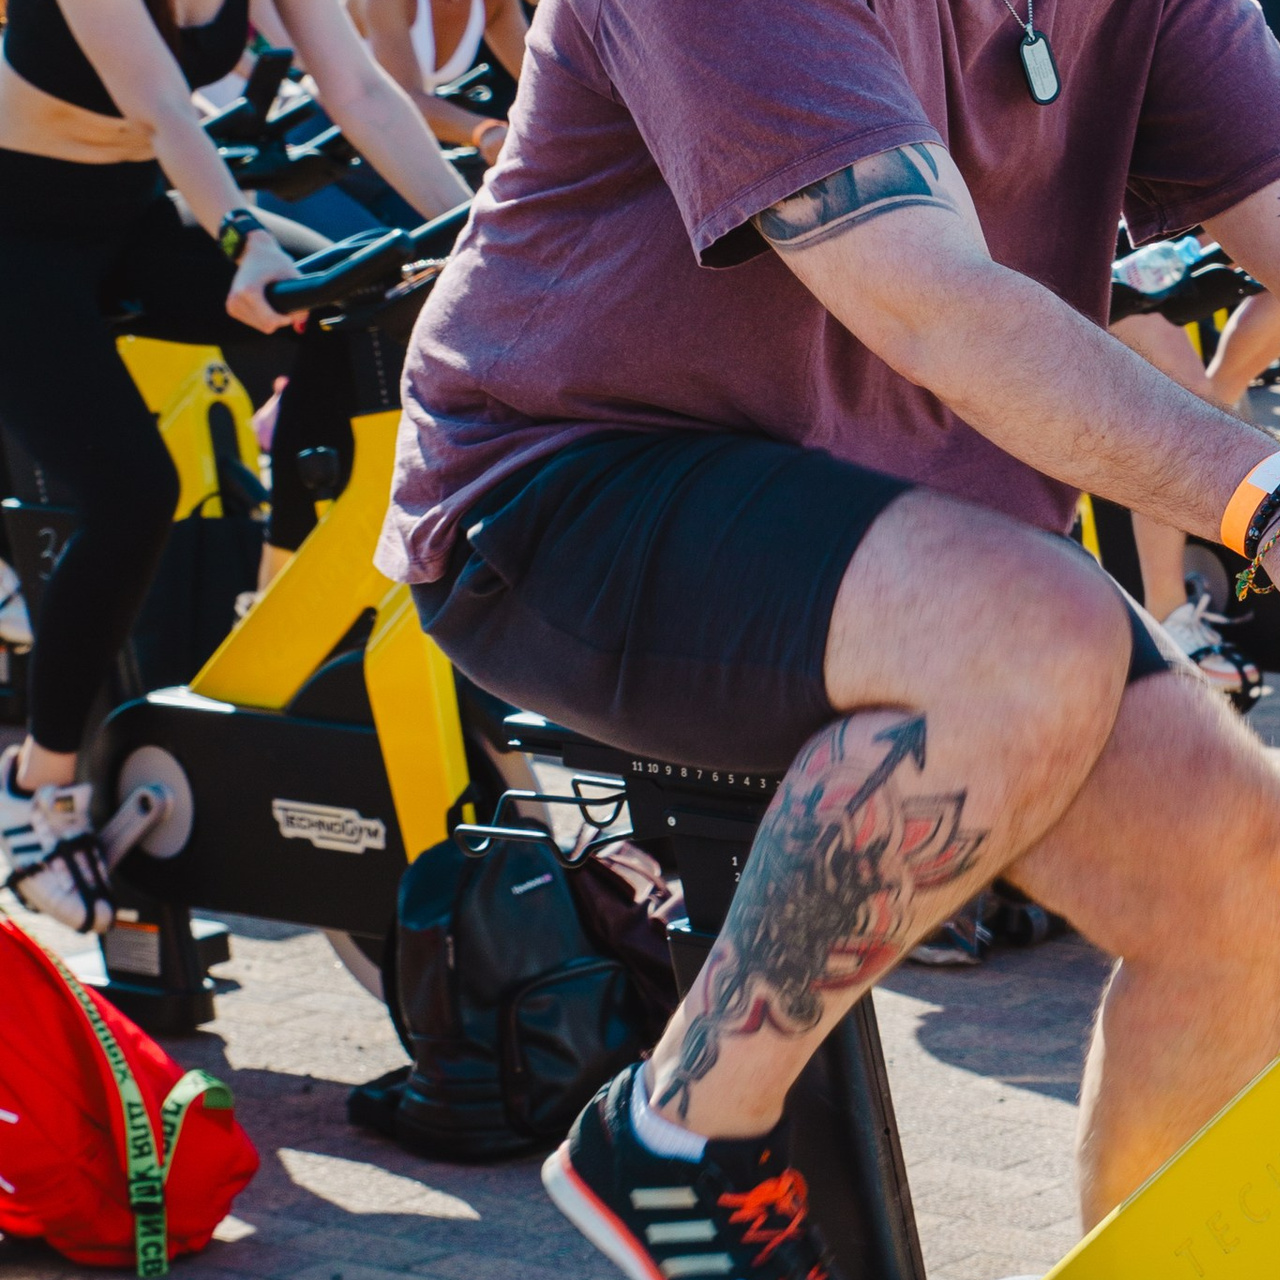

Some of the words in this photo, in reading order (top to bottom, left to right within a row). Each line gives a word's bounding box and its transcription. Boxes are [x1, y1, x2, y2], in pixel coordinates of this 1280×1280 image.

[632, 761, 643, 772] 11
[647, 763, 659, 774] 10
[665, 765, 672, 776] 9
[680, 767, 688, 778] 8
[696, 770, 703, 780] 7
[712, 772, 719, 782] 6
[728, 774, 735, 784] 5
[743, 776, 751, 786] 4
[759, 778, 767, 788] 3
[731, 856, 739, 867] 1
[734, 872, 741, 883] 2
